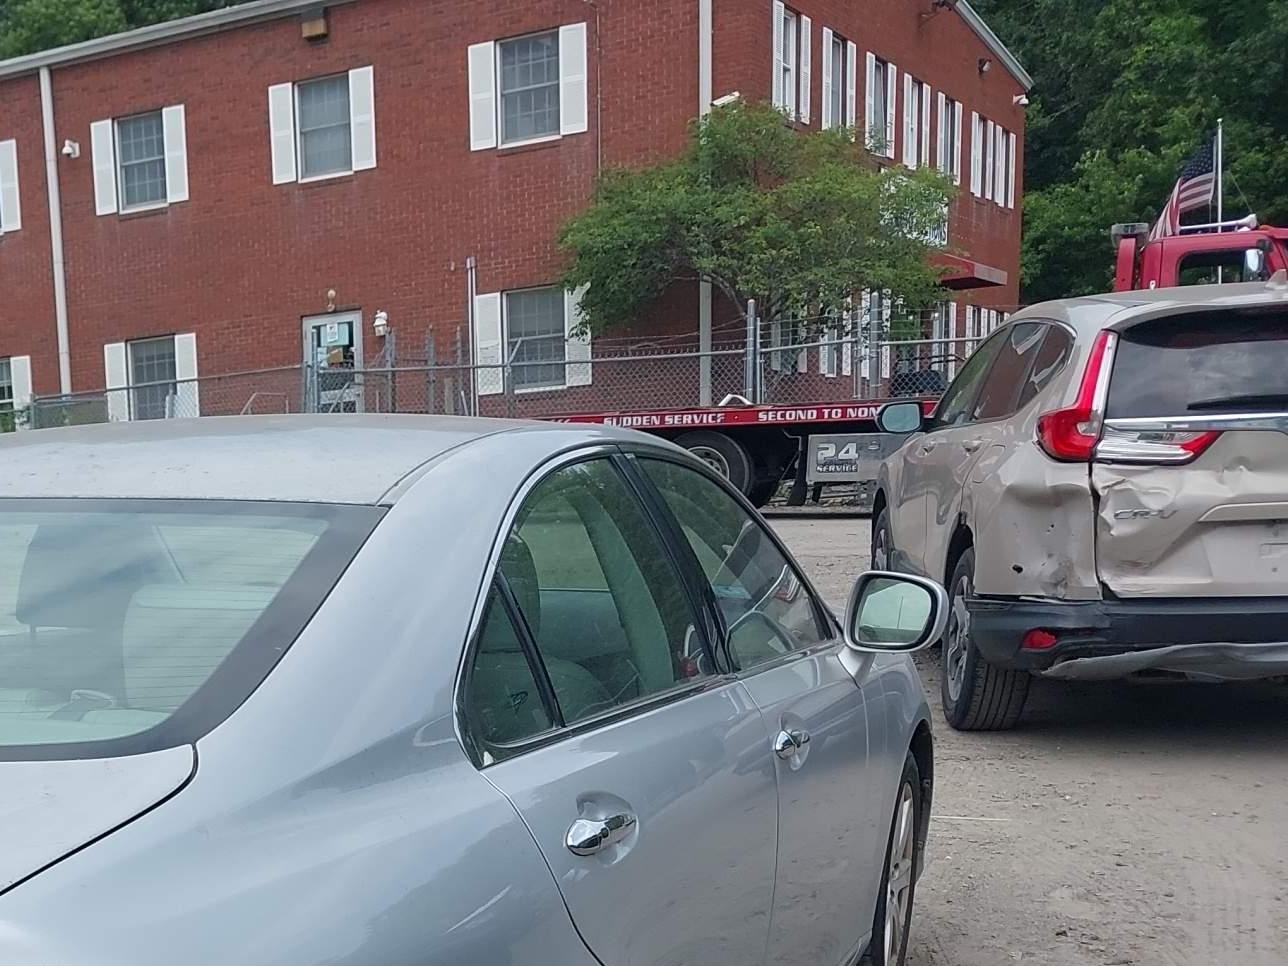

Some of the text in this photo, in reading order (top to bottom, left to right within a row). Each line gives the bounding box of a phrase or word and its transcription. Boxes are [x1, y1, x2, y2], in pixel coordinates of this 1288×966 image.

[603, 406, 882, 427] SUDDEN SERVICE SECOND TO NON
[816, 442, 859, 465] 24
[816, 464, 858, 473] SERVICE
[1113, 508, 1178, 520] CR-V
